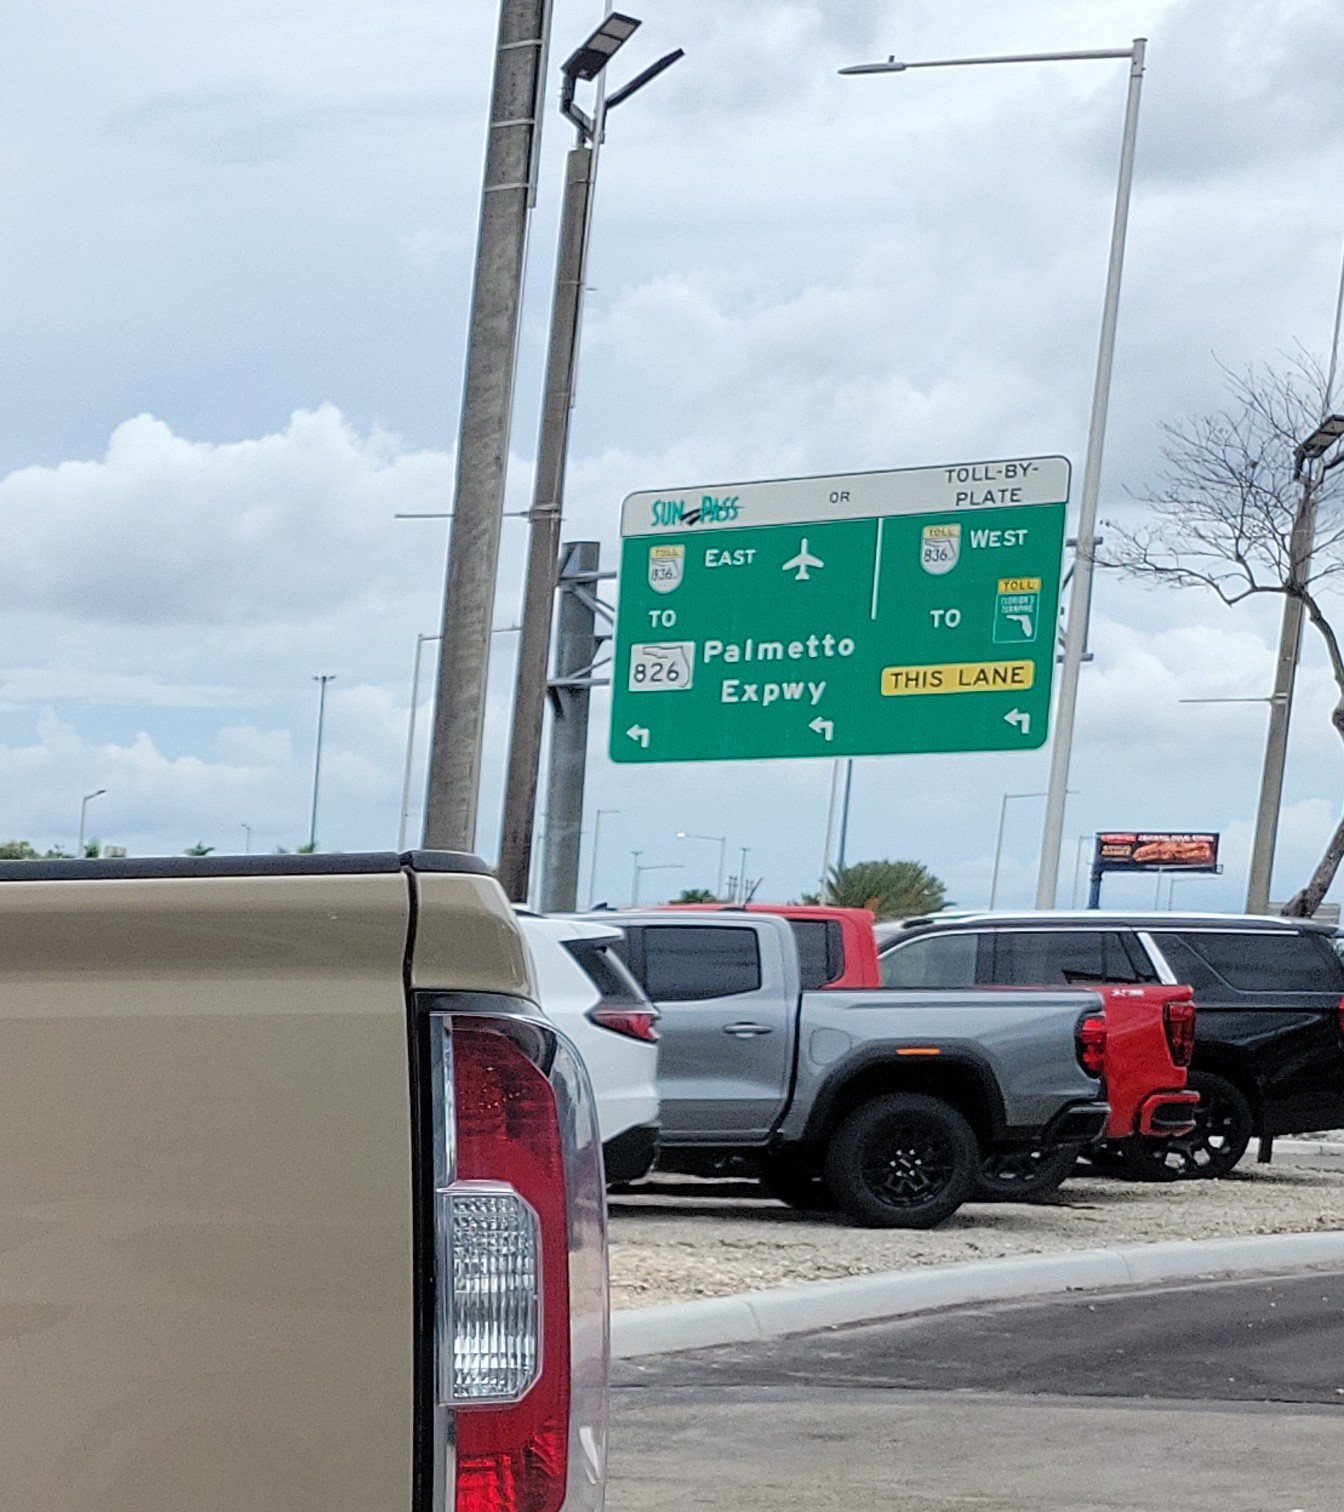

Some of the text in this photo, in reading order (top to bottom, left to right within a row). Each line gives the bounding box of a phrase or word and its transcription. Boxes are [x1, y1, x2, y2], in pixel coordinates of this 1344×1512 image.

[945, 462, 1039, 483] TOLL-BY-
[829, 491, 850, 504] OR
[955, 487, 1023, 506] PLATE
[970, 529, 1029, 549] WEST
[704, 548, 757, 568] EAST
[1003, 581, 1035, 591] TOLL
[648, 609, 677, 628] TO
[929, 608, 962, 628] TO
[633, 633, 856, 684] 826 Palmetto
[890, 666, 1026, 689] THIS LANE
[720, 679, 827, 707] Expwy
